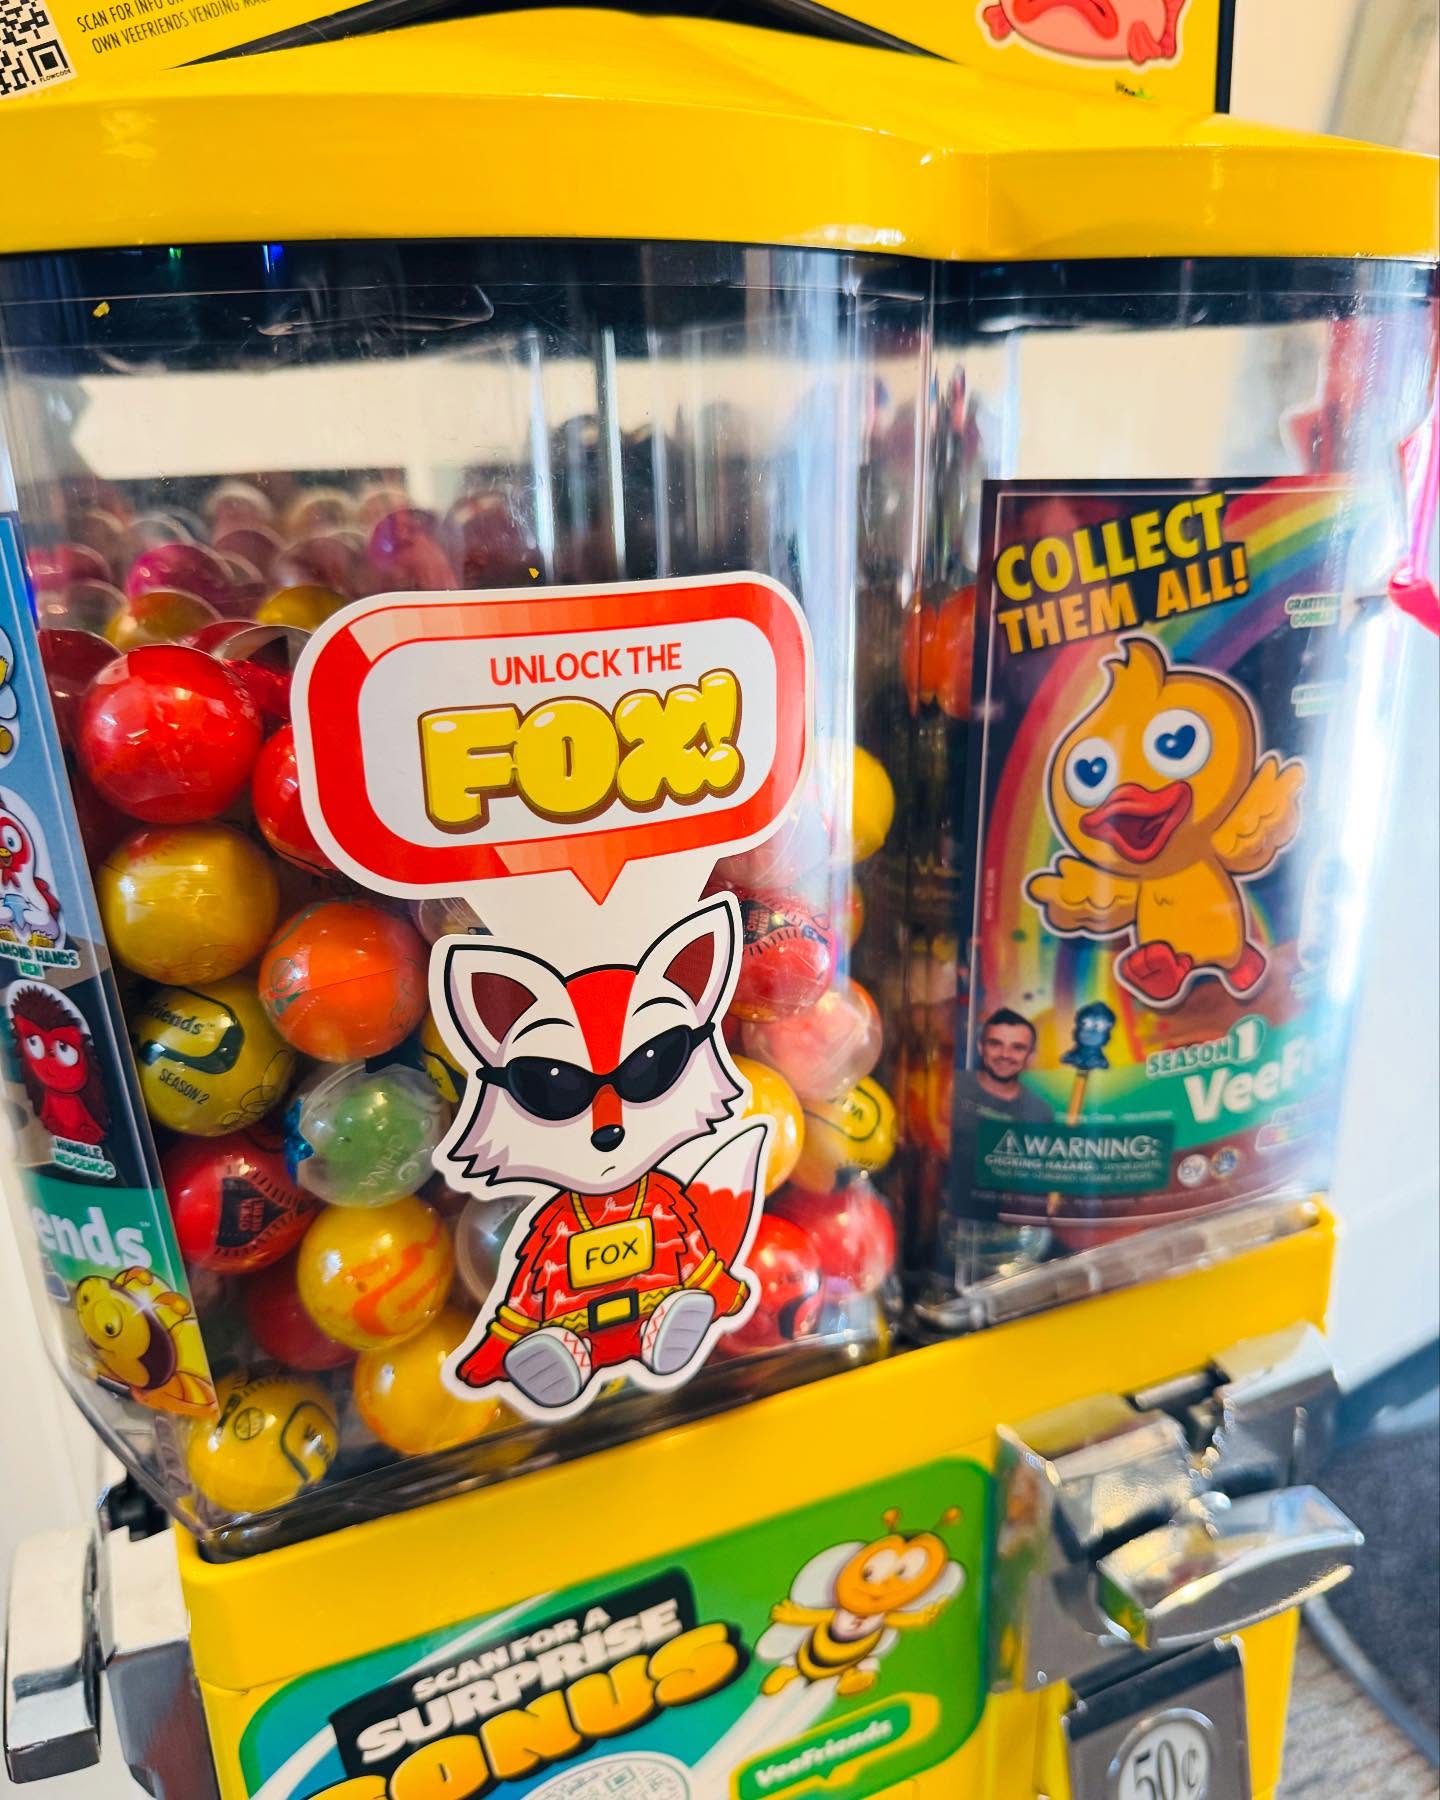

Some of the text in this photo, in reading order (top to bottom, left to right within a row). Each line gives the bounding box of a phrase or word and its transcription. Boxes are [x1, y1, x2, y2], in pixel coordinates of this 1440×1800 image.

[77, 10, 109, 33] SCAN
[109, 2, 134, 23] FOR
[92, 0, 240, 54] OWN VEEFRIENDS VENDING
[40, 68, 71, 83] FLOWCODE
[996, 492, 1225, 602] COLLECT
[997, 547, 1250, 655] THEM ALL!
[490, 642, 683, 687] UNLOCK THE
[418, 667, 746, 835] FOX!
[1147, 1019, 1257, 1077] SEASON 1
[159, 1067, 211, 1105] SEASON 2
[55, 1153, 115, 1178] HEDGEHOG
[1024, 1134, 1161, 1160] WARNING:
[585, 1237, 638, 1271] FOX
[356, 1598, 684, 1765] SURPRISE
[412, 1605, 613, 1700] SCAN FOR A
[306, 1621, 740, 1800] ONUS
[755, 1719, 893, 1789] VeeFriends
[1134, 1739, 1202, 1800] 50¢
